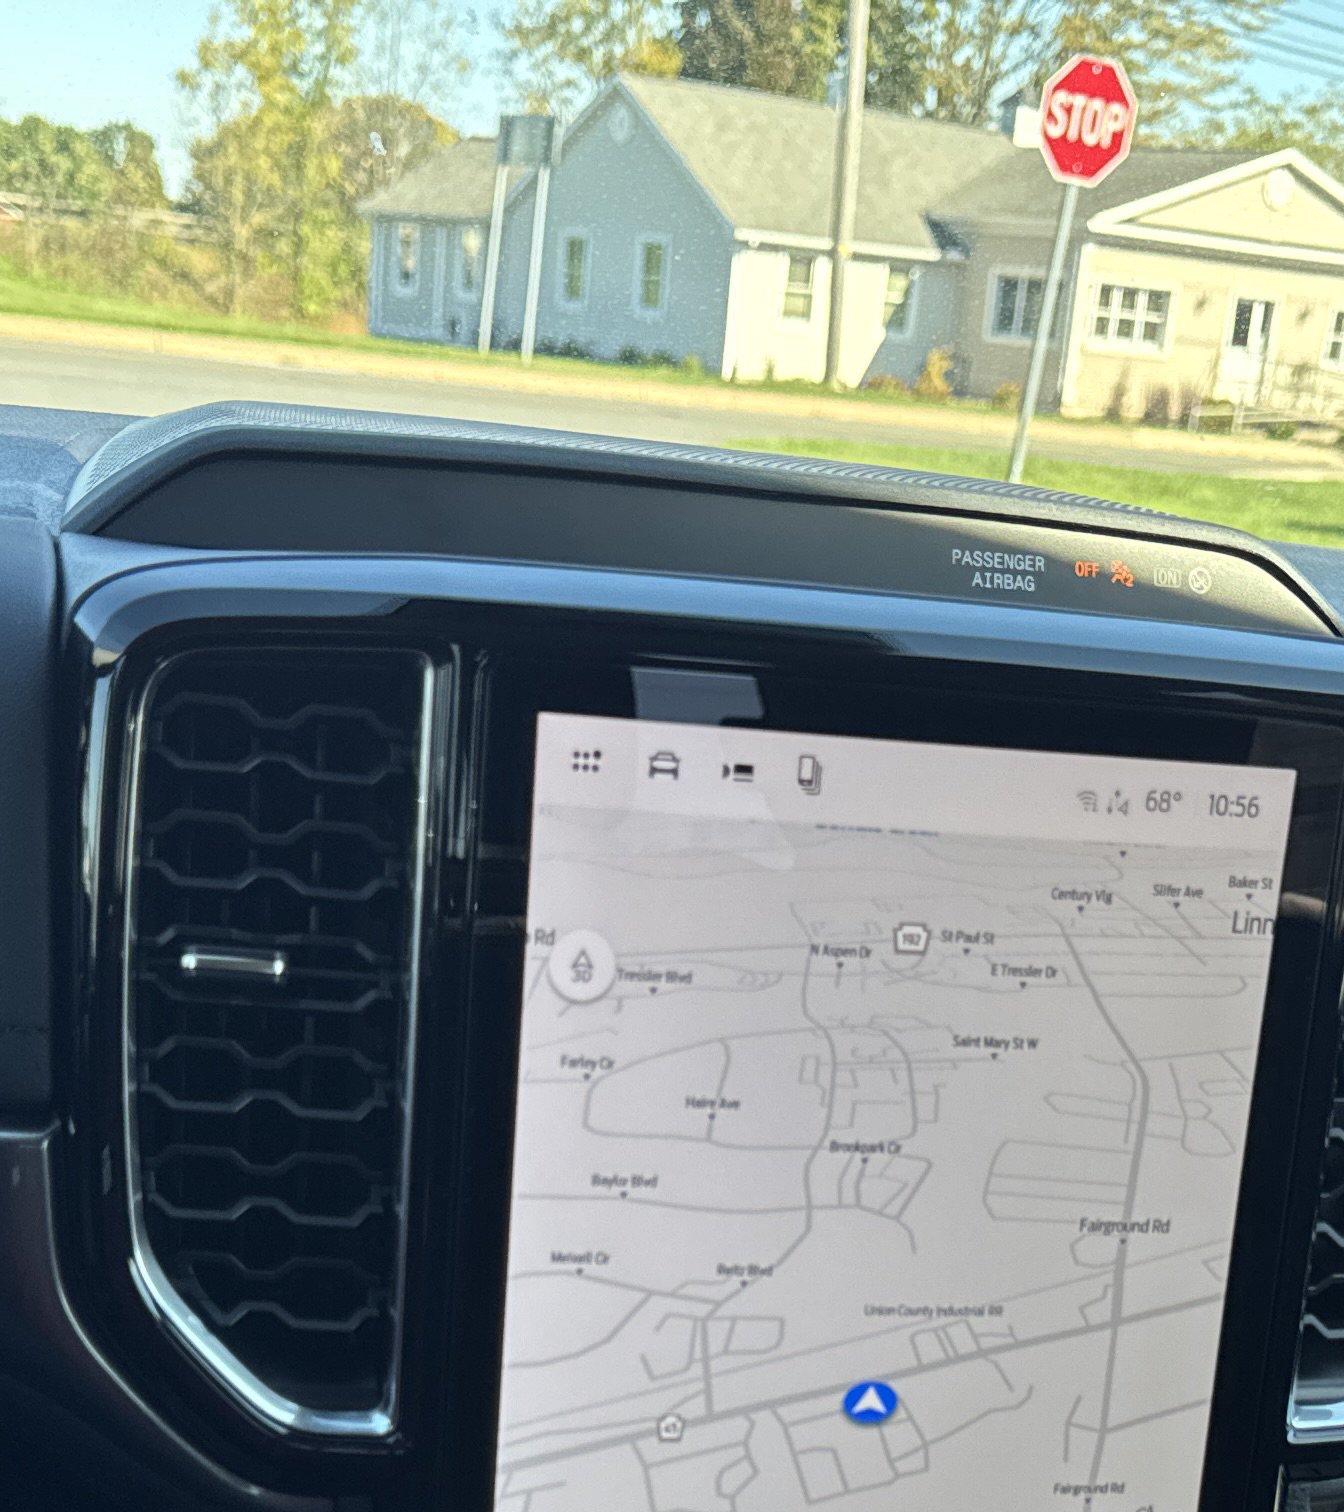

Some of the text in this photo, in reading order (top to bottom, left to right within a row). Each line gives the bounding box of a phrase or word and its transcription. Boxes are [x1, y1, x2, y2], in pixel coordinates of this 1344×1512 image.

[1045, 89, 1128, 150] STOP
[952, 549, 1045, 572] PASSENGER
[1074, 561, 1100, 578] OFF
[1158, 568, 1178, 585] ON
[972, 572, 1036, 592] AIRBAG
[1209, 794, 1260, 818] 10:56
[1228, 875, 1273, 890] Baker St
[1050, 887, 1093, 905] Century
[1152, 884, 1204, 899] Slifer Ave
[534, 928, 556, 946] Rd
[902, 933, 922, 947] 192
[941, 930, 994, 945] St Paul St
[991, 963, 1058, 979] E Tressler Dr
[953, 1034, 1040, 1052] Saint Mary St W
[1078, 1218, 1171, 1236] Fairground Rd
[1053, 1482, 1125, 1497] Fairground Rd
